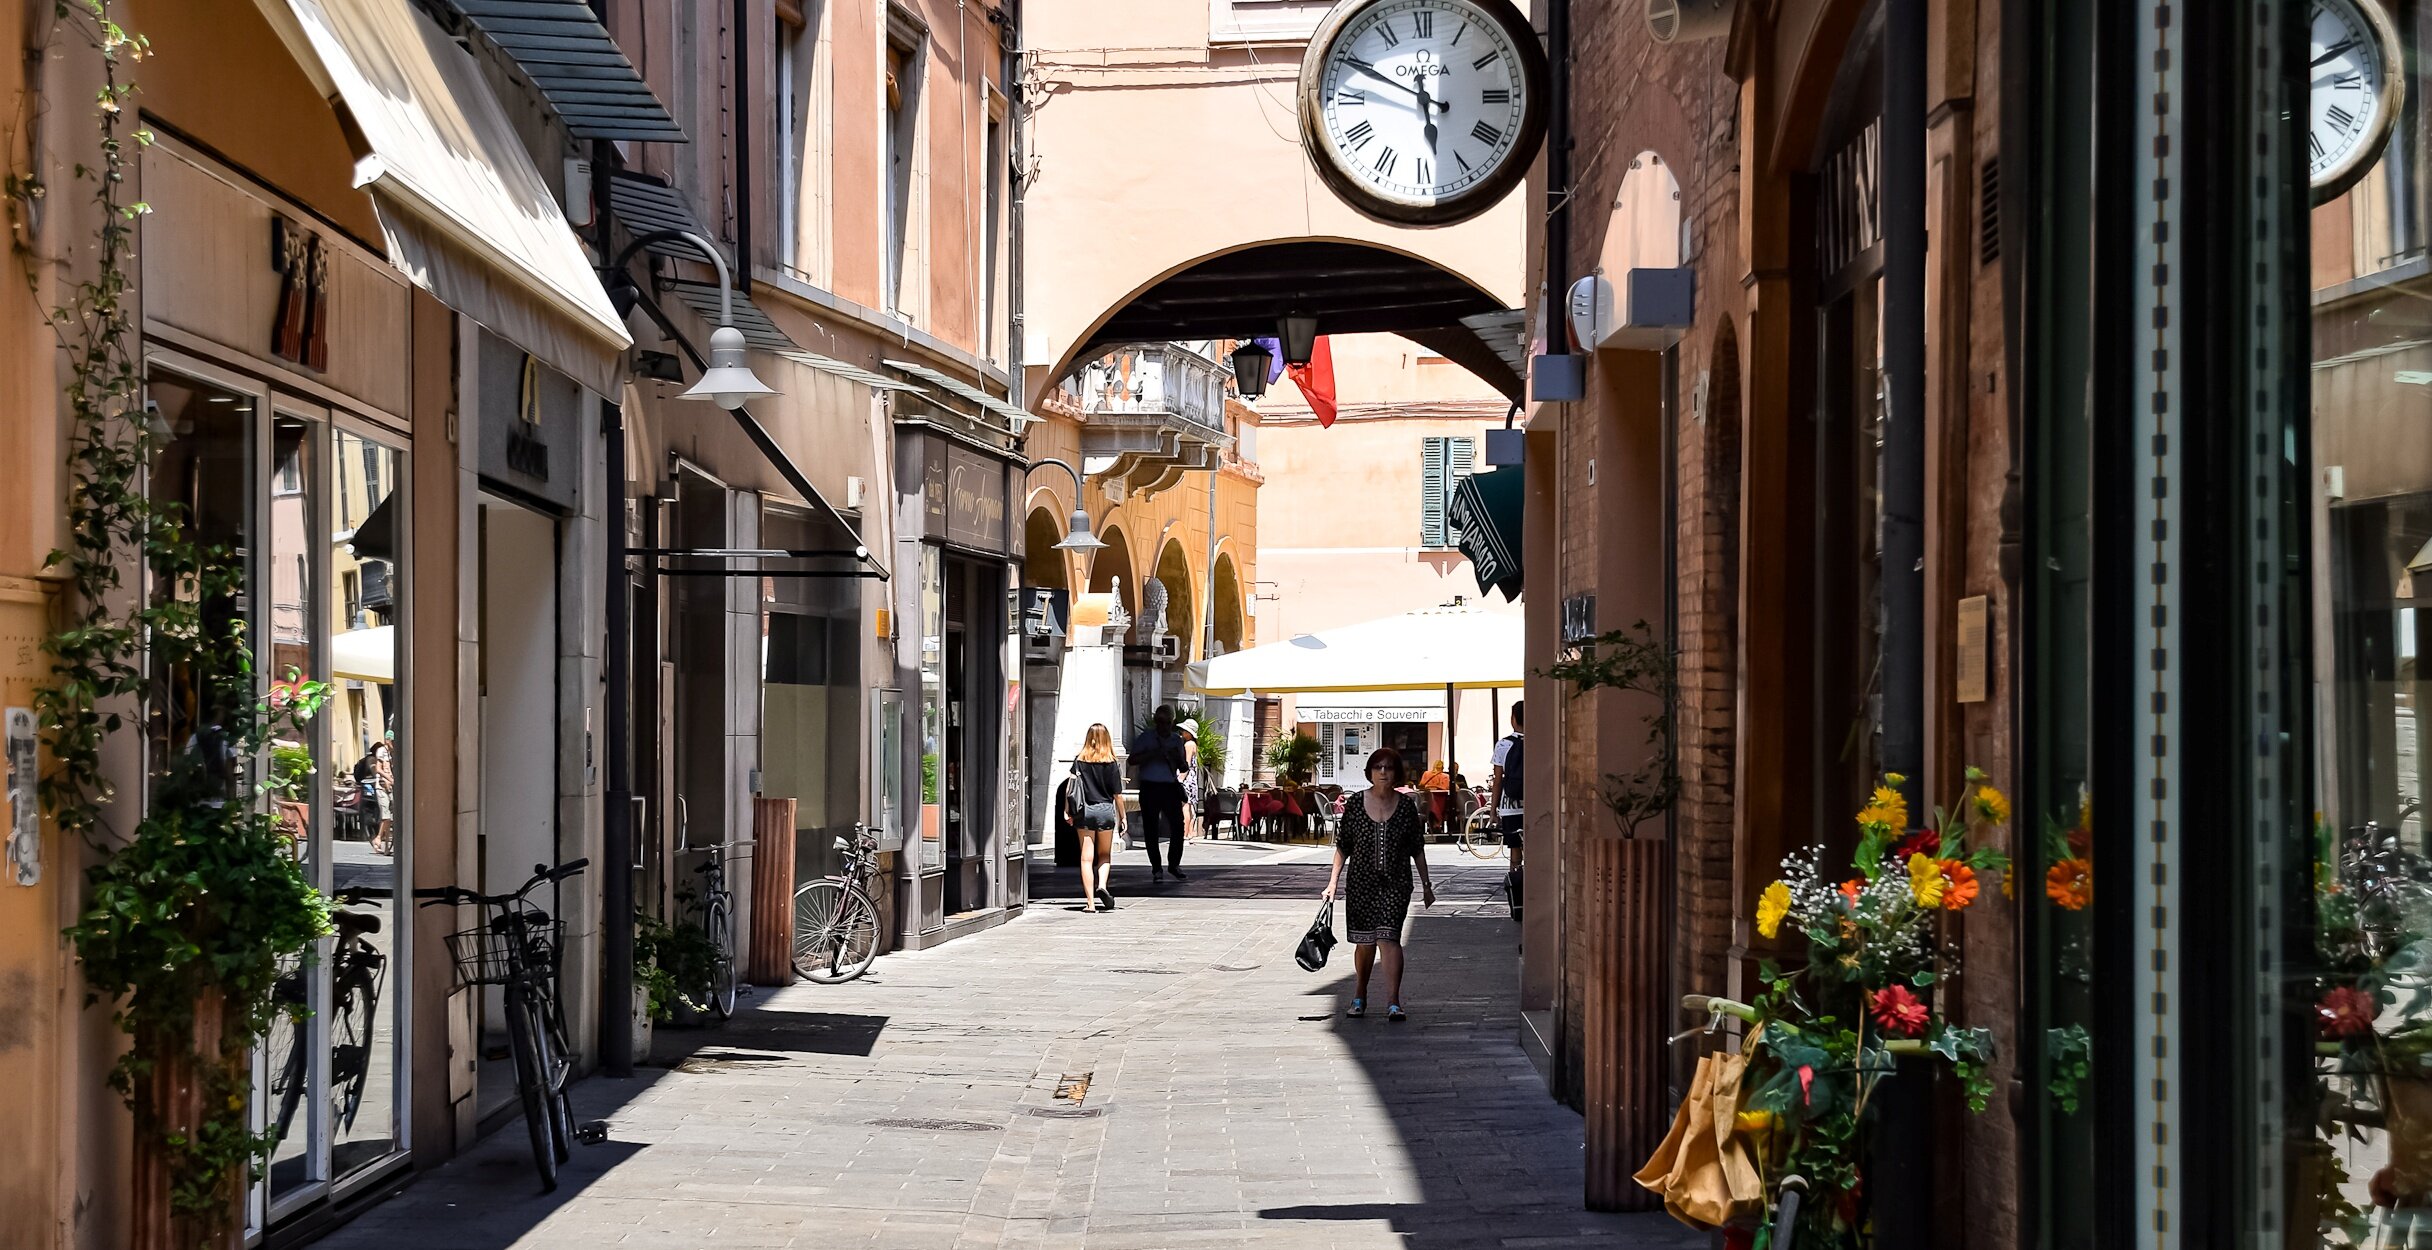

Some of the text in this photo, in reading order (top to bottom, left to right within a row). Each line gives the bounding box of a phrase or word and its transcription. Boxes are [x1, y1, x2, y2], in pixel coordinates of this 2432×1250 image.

[1374, 21, 1400, 51] XI
[1412, 11, 1433, 39] XII
[1395, 64, 1451, 77] OMEGA
[1472, 49, 1500, 72] II
[1337, 89, 1365, 106] IX
[1482, 88, 1510, 104] III
[1344, 119, 1376, 152] VIII
[1374, 146, 1399, 178] VII
[1416, 157, 1432, 184] VI
[1452, 148, 1472, 175] V
[1313, 709, 1427, 720] Tabacchi e Souvenir
